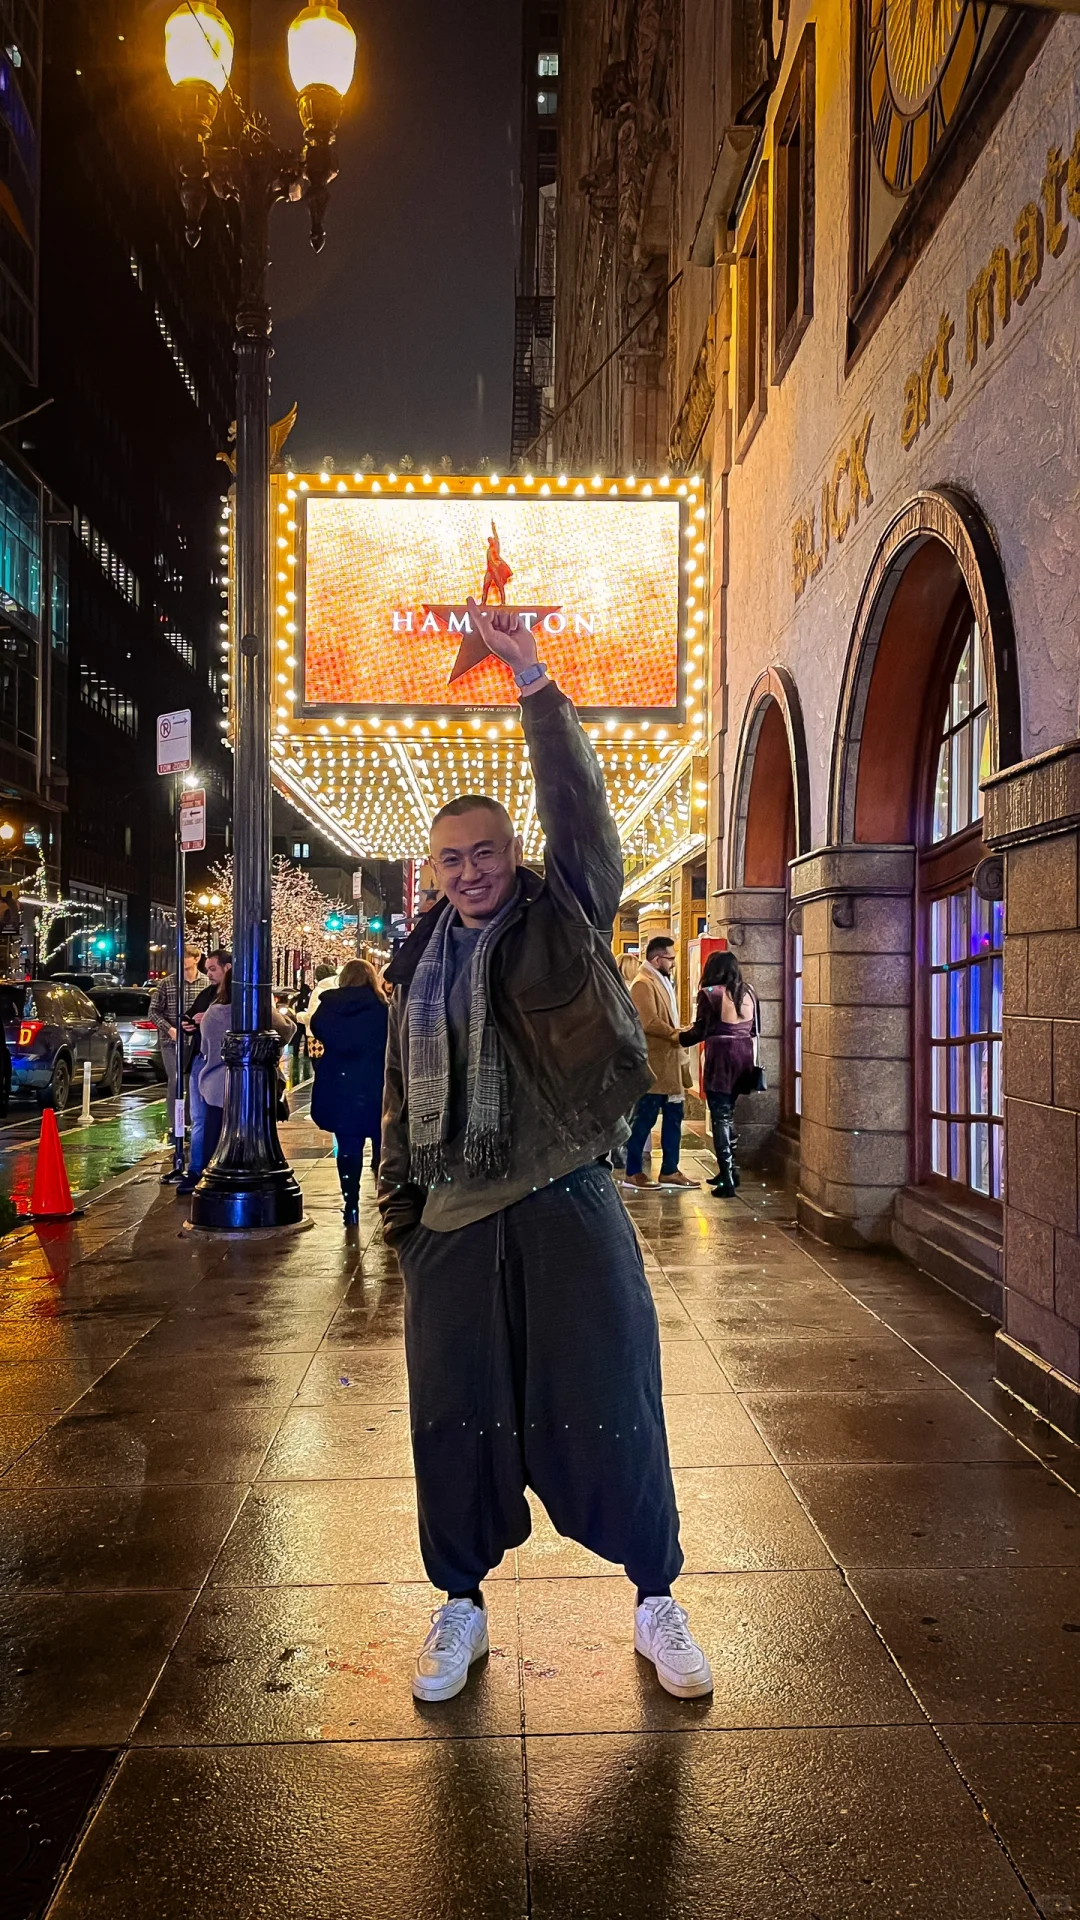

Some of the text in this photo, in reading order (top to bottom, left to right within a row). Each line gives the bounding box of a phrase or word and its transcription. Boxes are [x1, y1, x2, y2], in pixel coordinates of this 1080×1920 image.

[791, 407, 872, 600] BLICK
[901, 312, 952, 449] art
[392, 611, 597, 634] HAMTON
[160, 760, 188, 773] TOW ZONE
